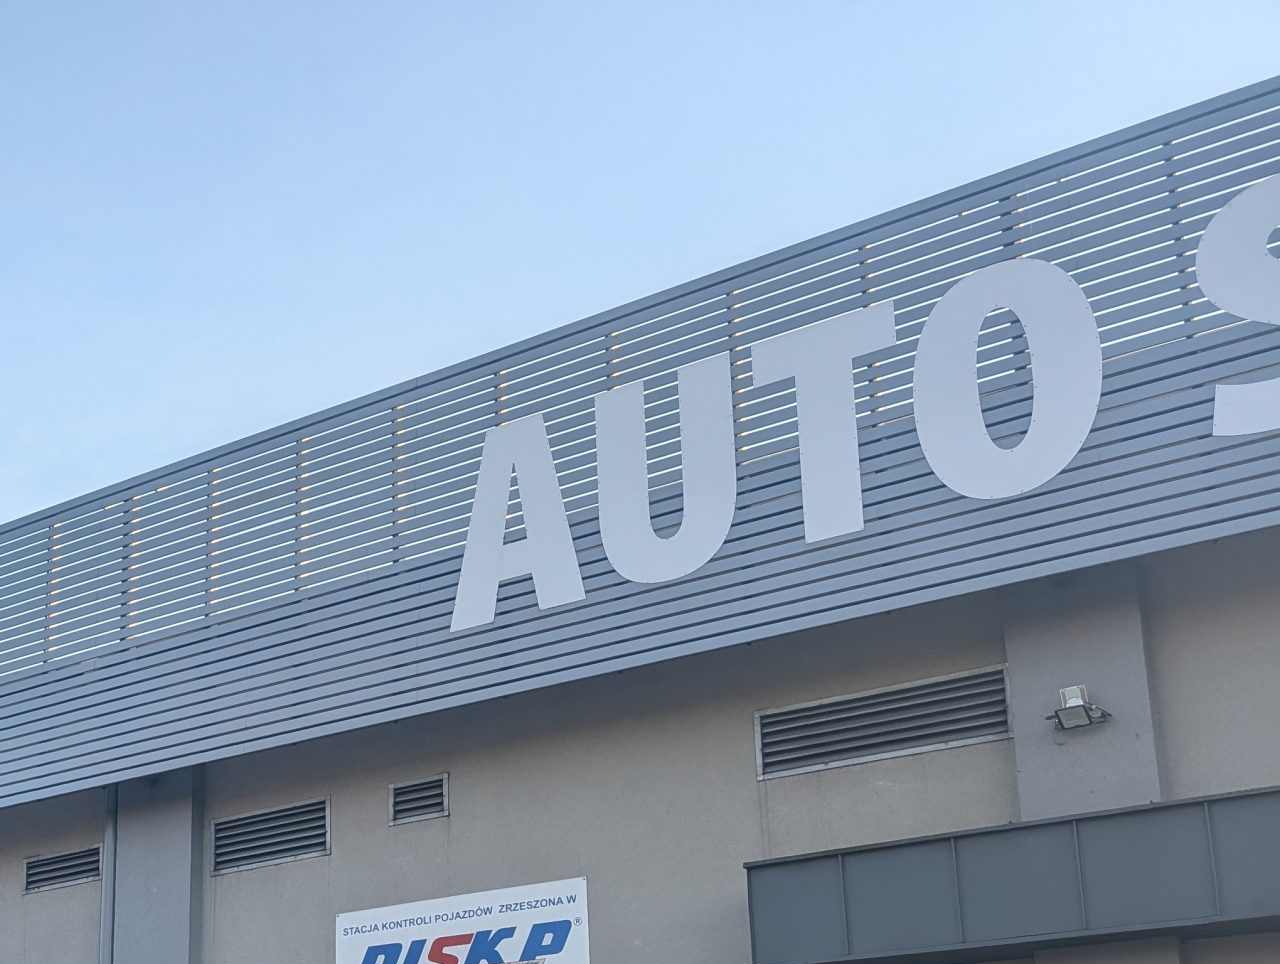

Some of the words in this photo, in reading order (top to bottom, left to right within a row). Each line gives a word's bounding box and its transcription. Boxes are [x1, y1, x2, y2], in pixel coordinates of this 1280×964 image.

[450, 258, 1103, 632] AUTO
[343, 924, 379, 936] STACJA
[382, 916, 431, 931] KONTROLI
[435, 906, 493, 923] POJAZDÓW
[499, 898, 564, 913] ZRZESZONA
[566, 895, 577, 904] W
